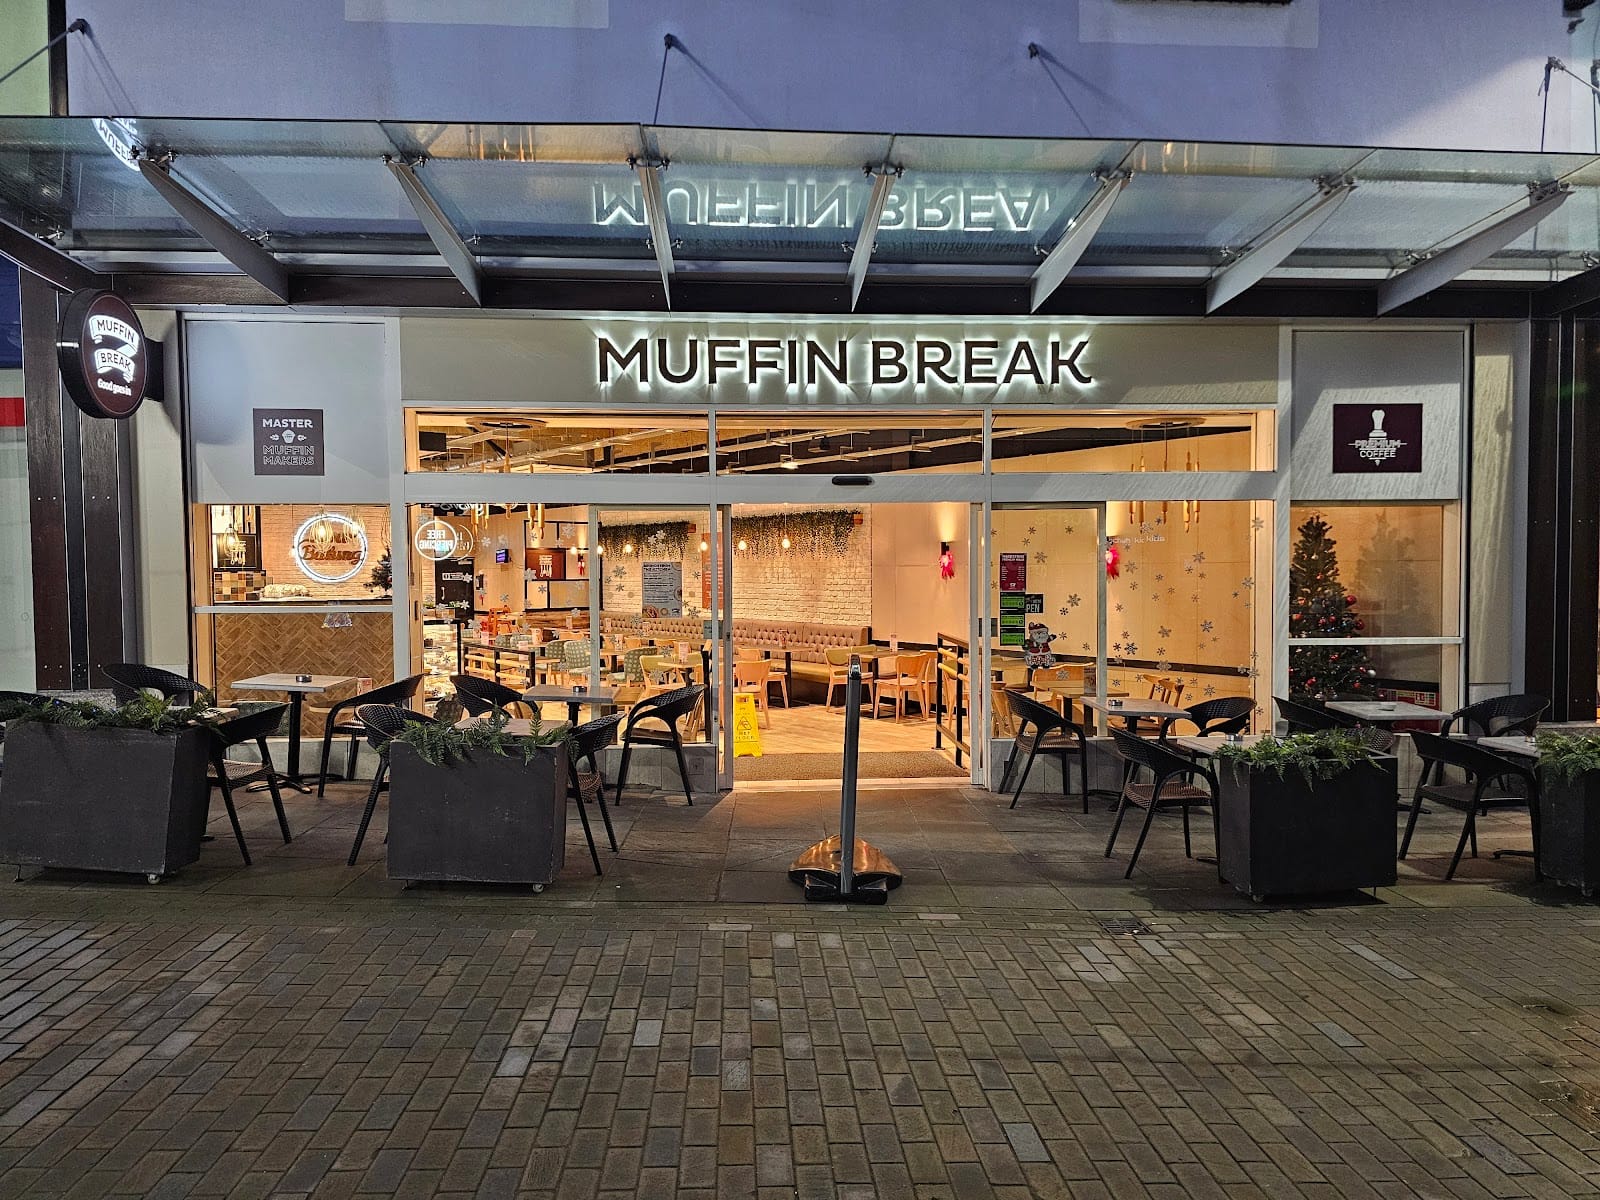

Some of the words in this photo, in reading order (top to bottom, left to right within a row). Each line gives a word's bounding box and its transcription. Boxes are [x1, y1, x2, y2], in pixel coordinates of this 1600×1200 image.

[97, 319, 135, 343] MUFFIN
[100, 352, 132, 372] BREAK
[599, 338, 848, 385] MUFFIN
[871, 340, 1093, 385] BREAK
[262, 418, 314, 428] MASTER
[1354, 439, 1402, 449] PREMIUM
[262, 445, 315, 455] MUFFIN
[1360, 450, 1397, 458] COFFEE
[263, 455, 315, 466] MAKERS
